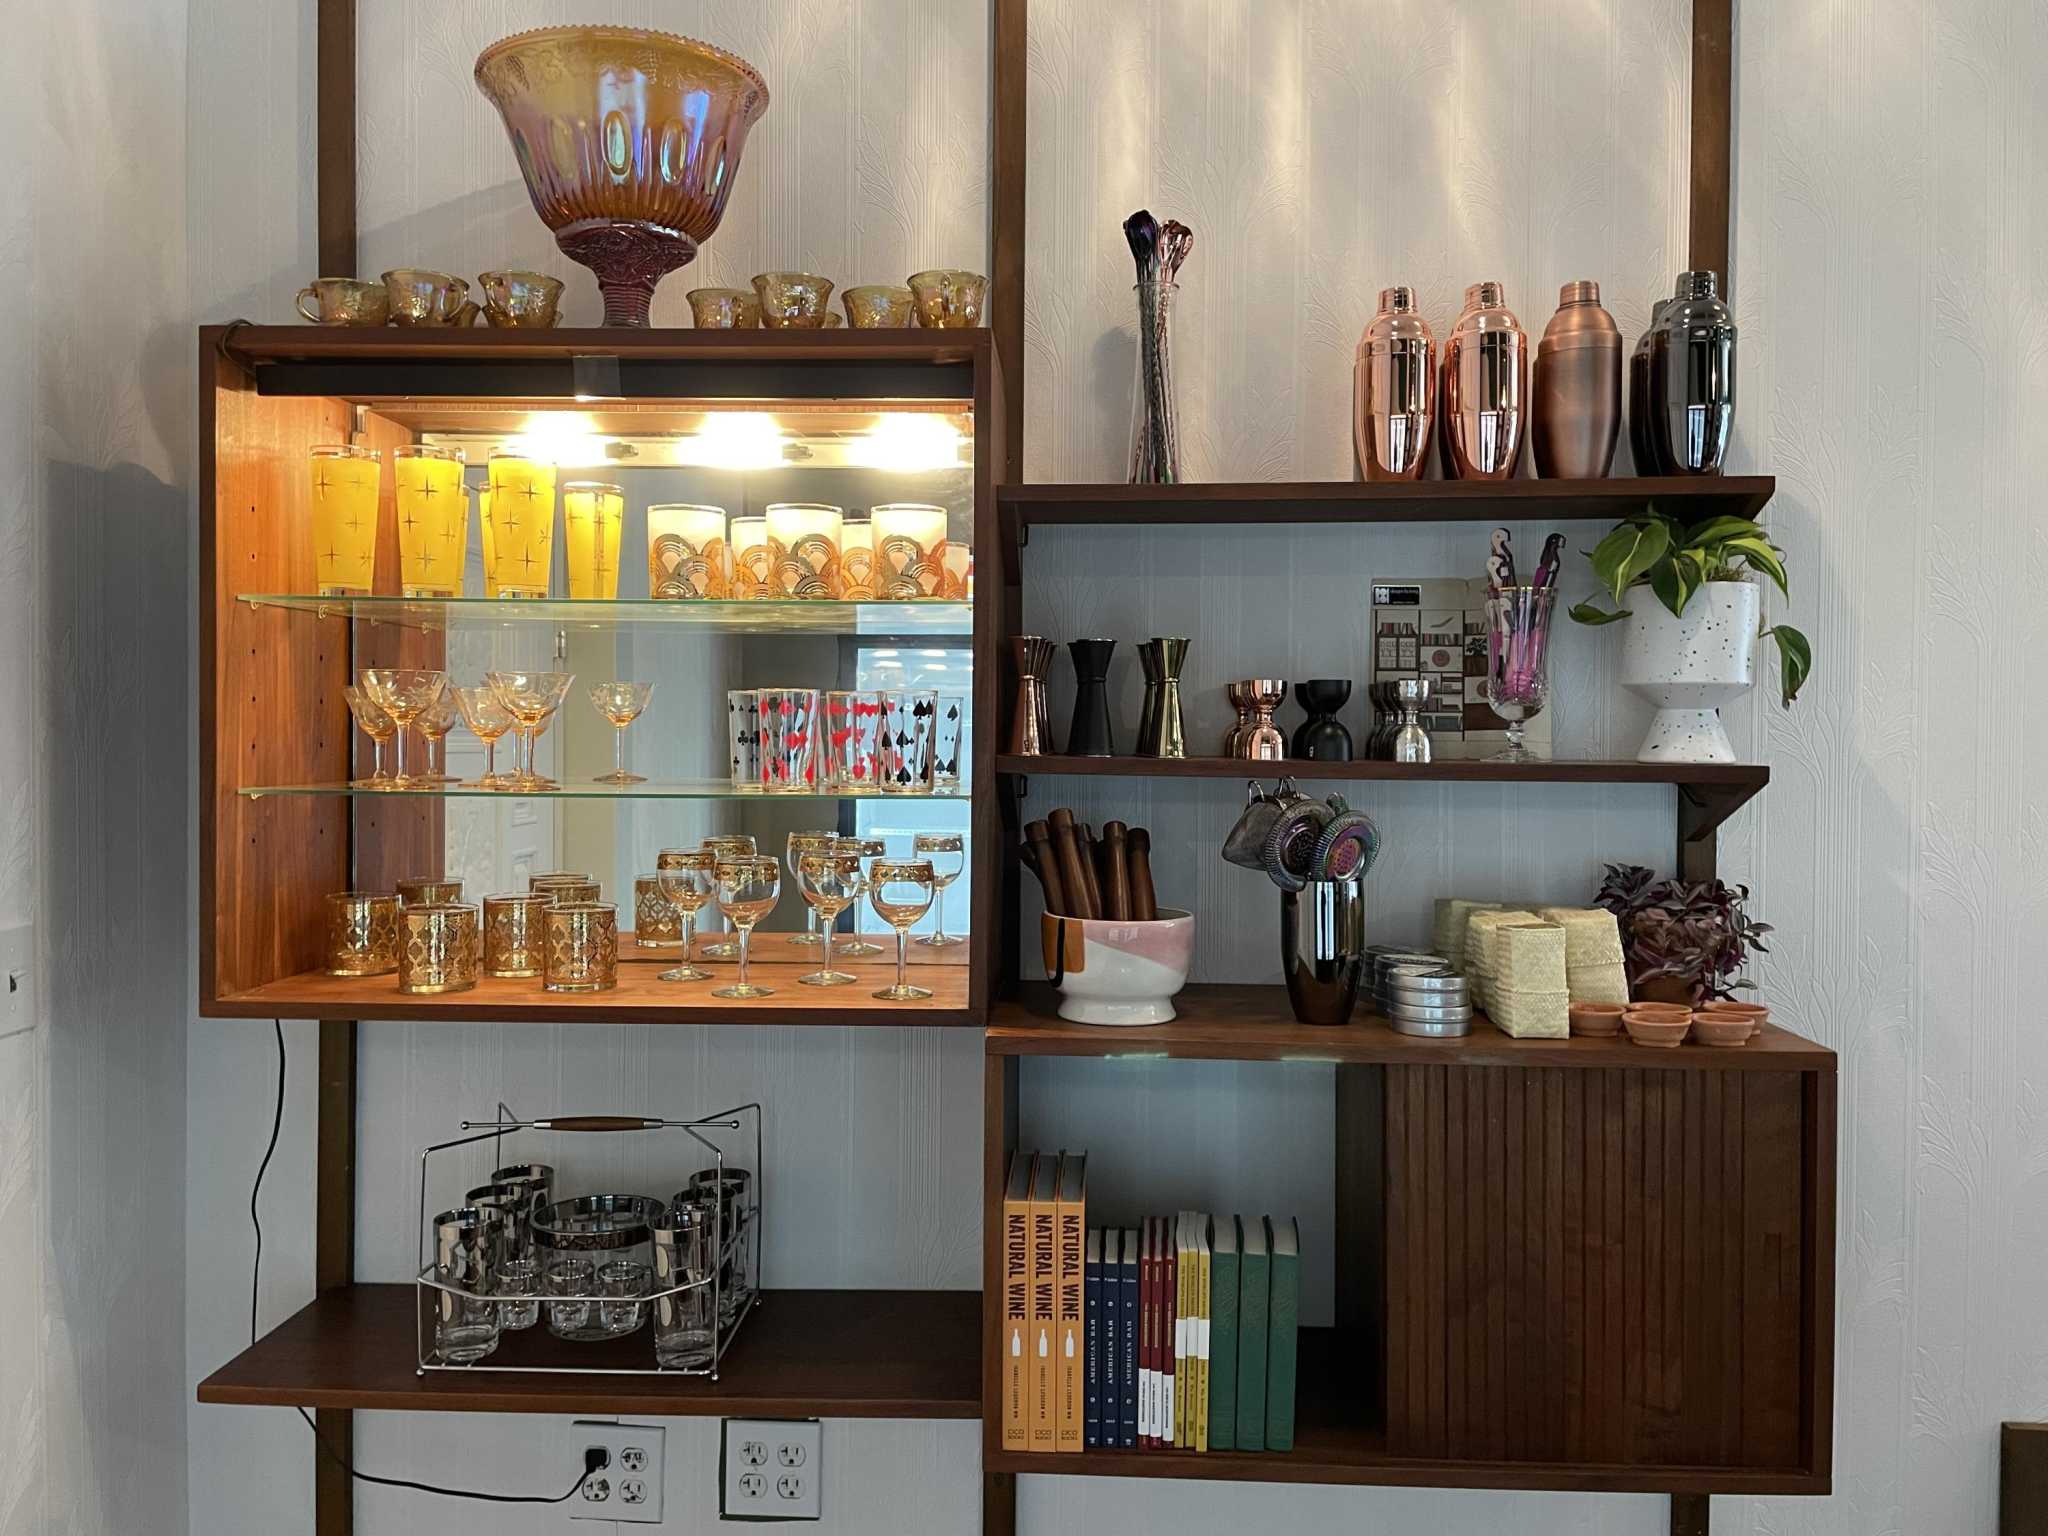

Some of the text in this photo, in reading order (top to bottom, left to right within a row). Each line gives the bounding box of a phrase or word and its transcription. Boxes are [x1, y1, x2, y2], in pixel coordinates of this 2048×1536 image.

[1009, 1214, 1026, 1320] NATURAL WINE
[1036, 1214, 1053, 1320] NATURAL WINE
[1062, 1215, 1079, 1321] NATURAL WINE
